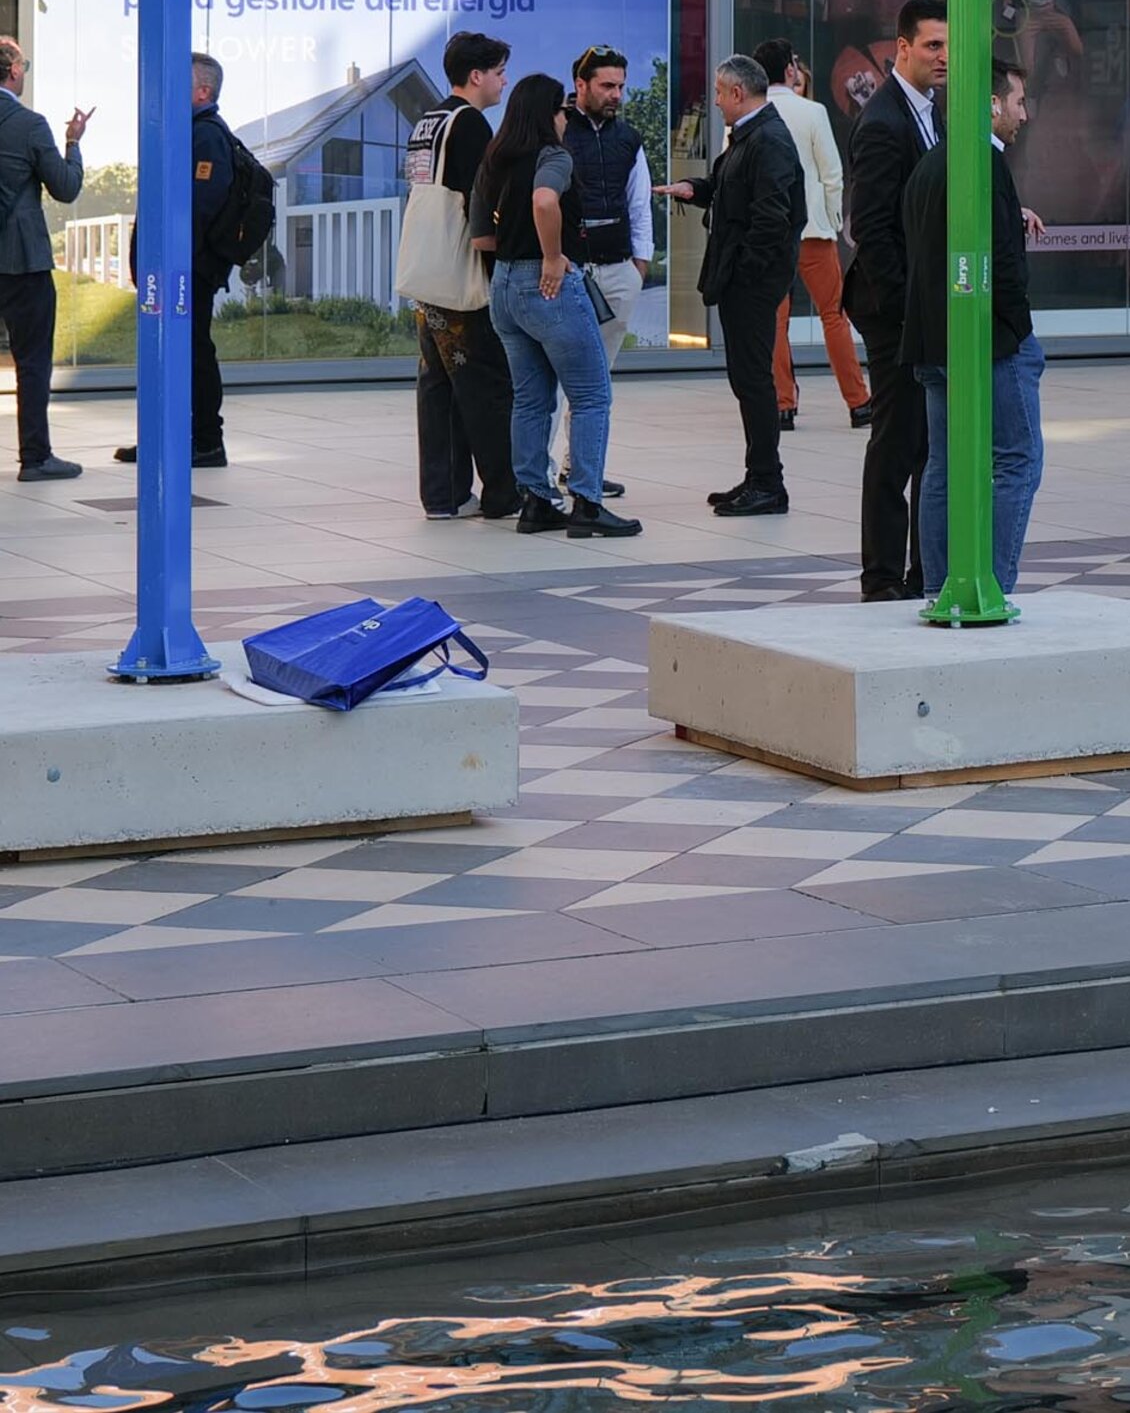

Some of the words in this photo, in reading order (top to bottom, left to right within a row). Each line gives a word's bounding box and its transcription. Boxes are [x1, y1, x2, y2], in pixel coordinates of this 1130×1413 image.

[121, 34, 317, 63] SPOWER
[1080, 231, 1106, 245] and
[956, 256, 969, 285] bryo
[145, 273, 158, 306] bryo
